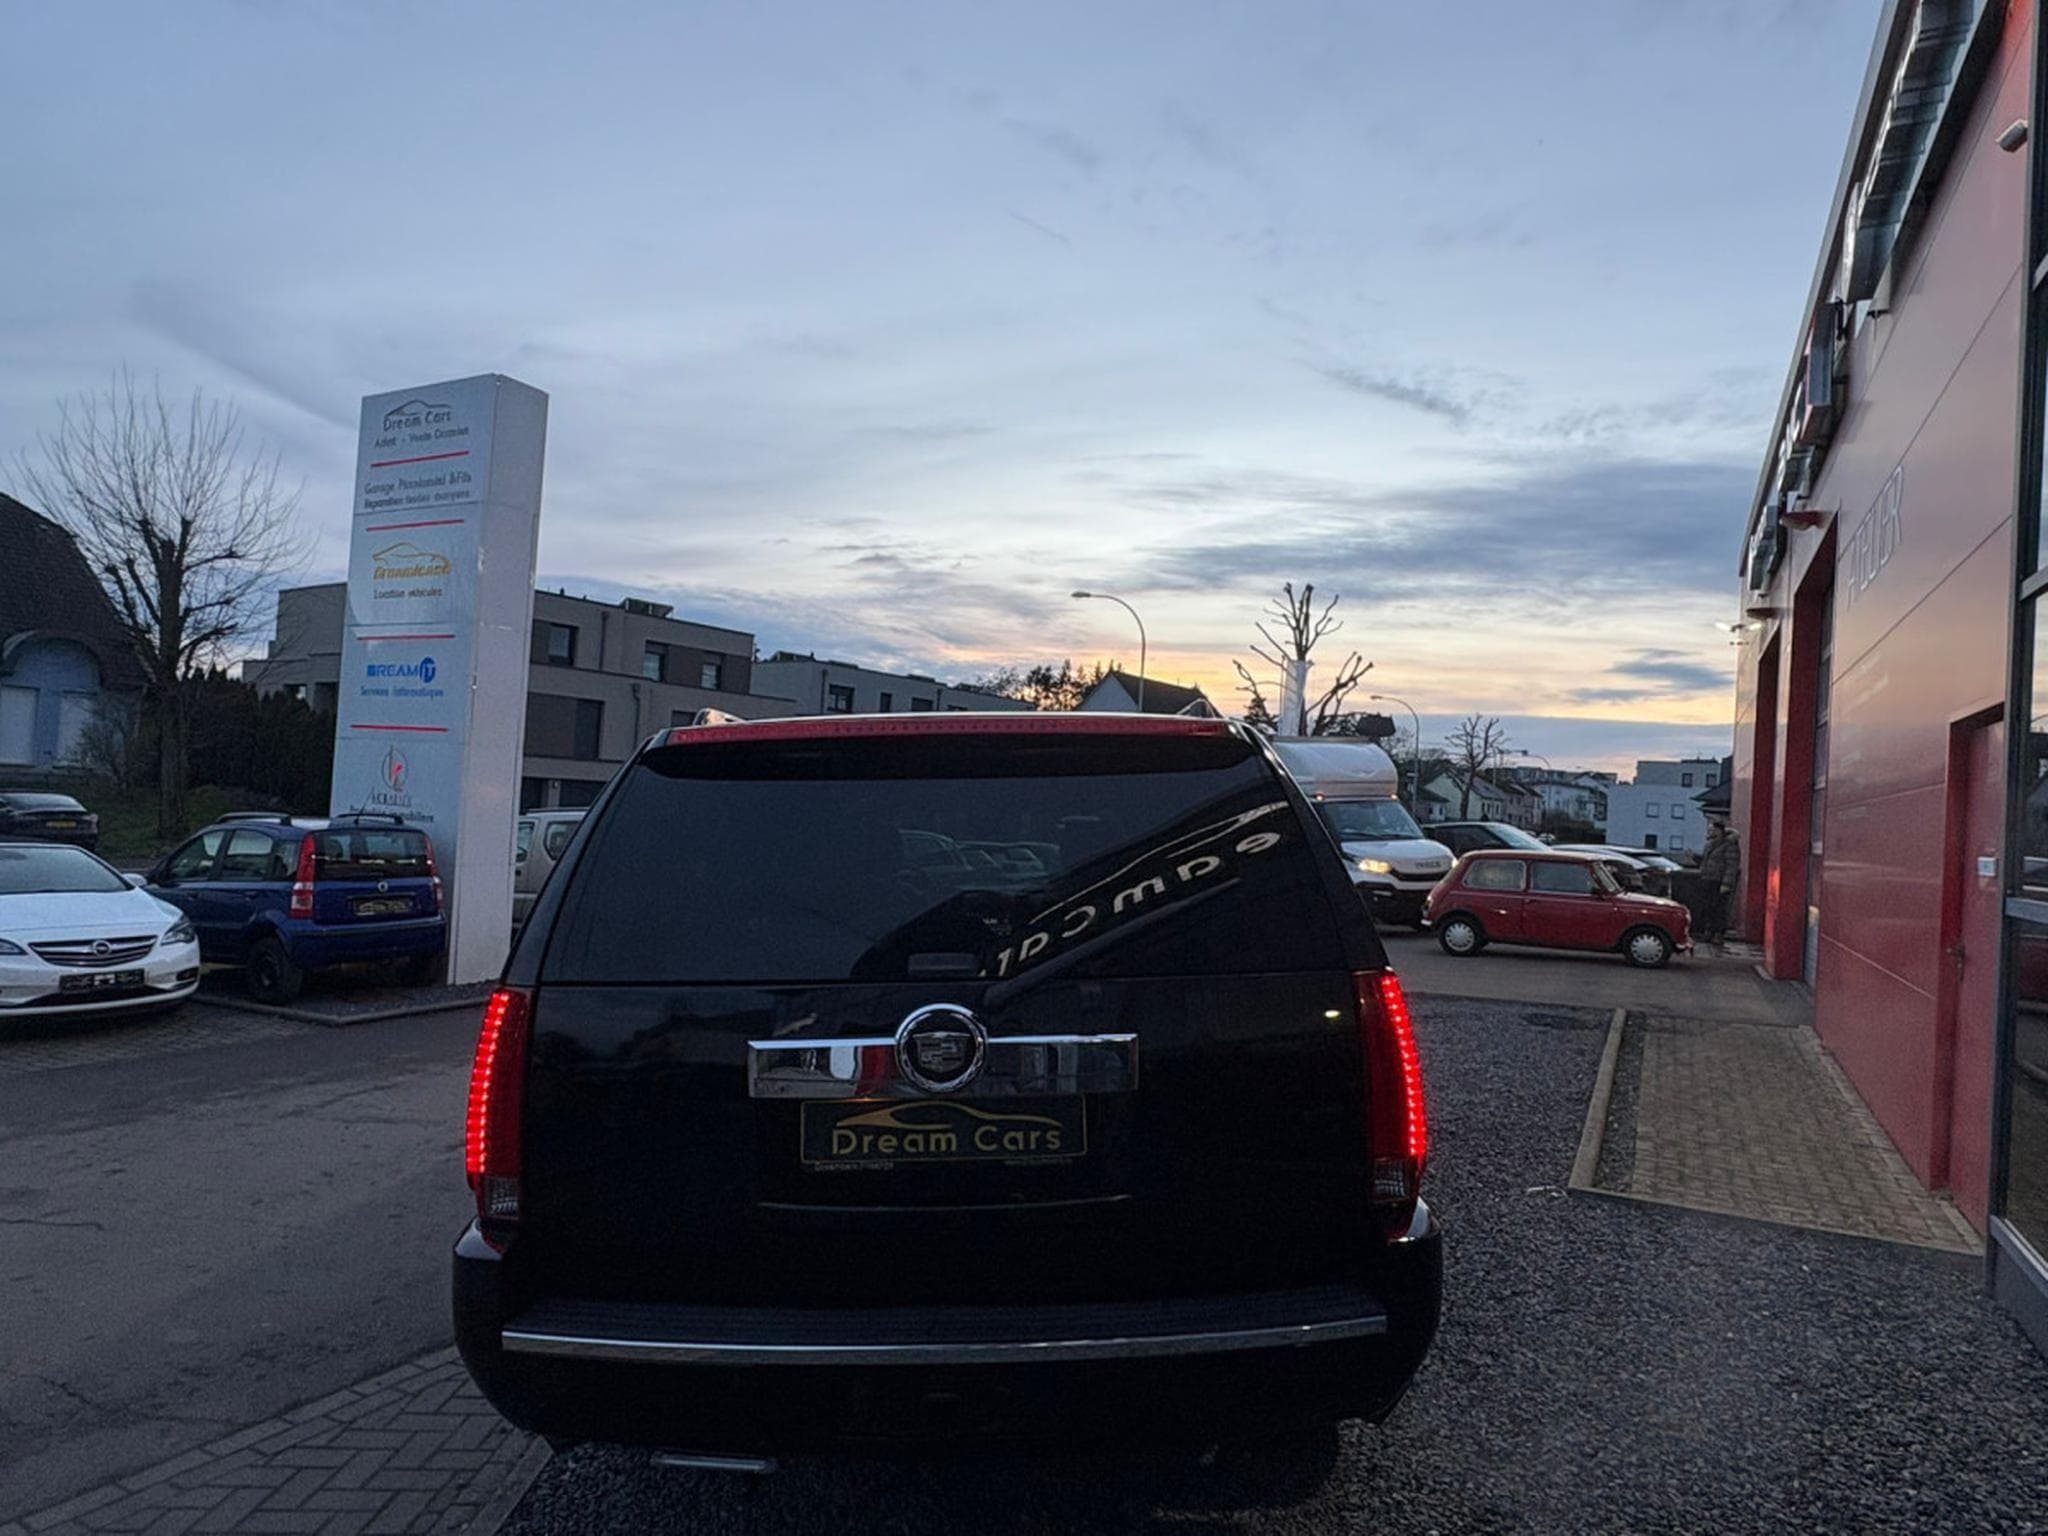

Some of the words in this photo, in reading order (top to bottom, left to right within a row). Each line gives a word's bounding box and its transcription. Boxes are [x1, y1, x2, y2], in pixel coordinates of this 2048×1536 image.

[383, 417, 421, 432] Dream
[425, 410, 451, 423] Cars
[832, 1129, 957, 1155] Dream
[974, 1125, 1062, 1151] Cars
